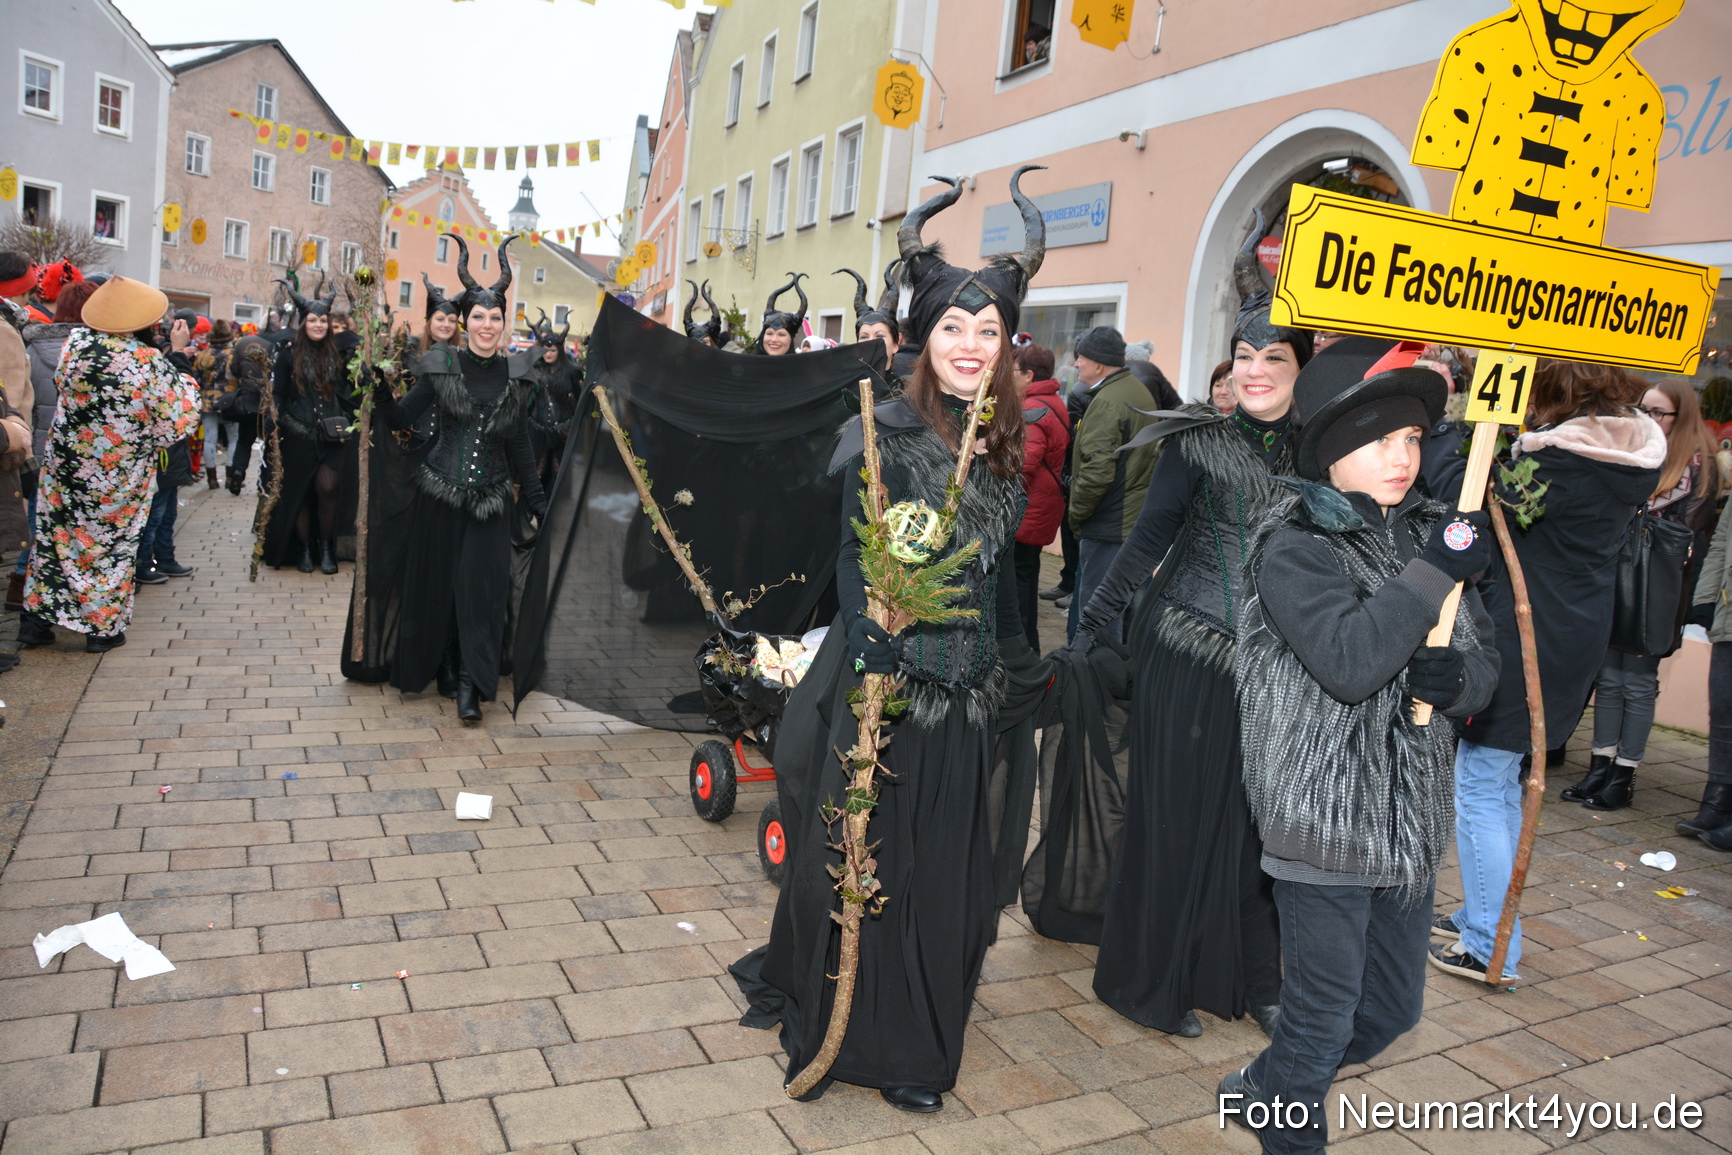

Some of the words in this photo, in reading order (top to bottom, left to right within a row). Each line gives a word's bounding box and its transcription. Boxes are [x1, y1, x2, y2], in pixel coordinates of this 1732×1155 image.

[1315, 231, 1375, 295] Die
[1384, 243, 1689, 341] Faschingsnarrischen
[1477, 363, 1527, 413] 41
